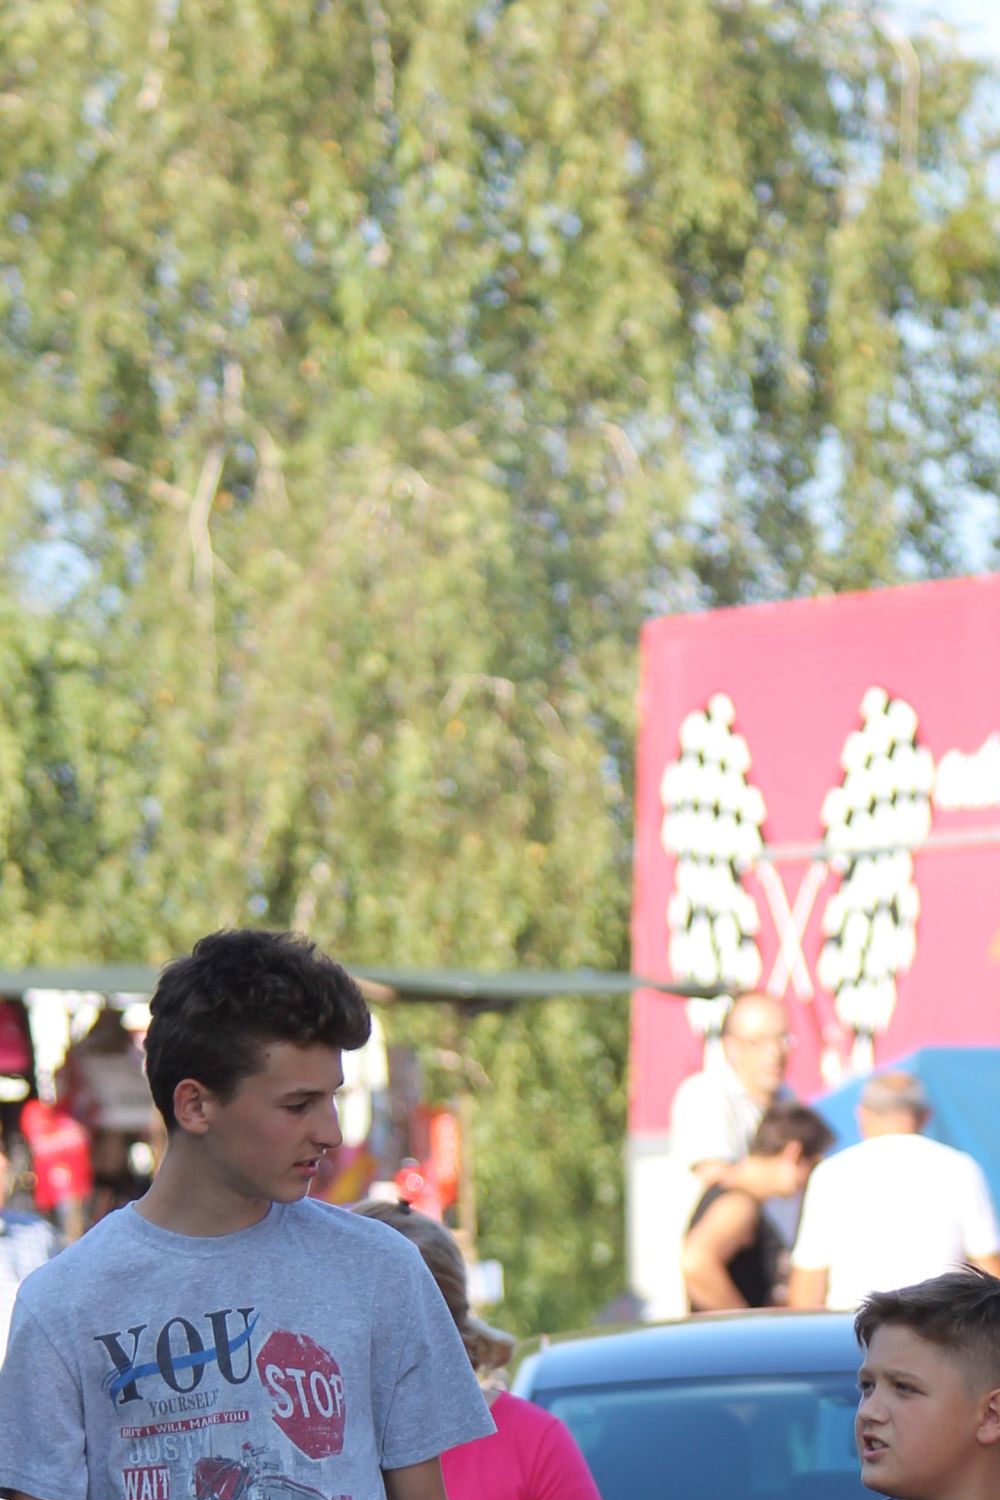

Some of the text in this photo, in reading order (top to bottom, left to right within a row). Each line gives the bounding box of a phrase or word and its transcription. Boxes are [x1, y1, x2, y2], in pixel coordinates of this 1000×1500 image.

[93, 1307, 255, 1404] YOU
[150, 1389, 219, 1417] YOURSELF
[265, 1363, 343, 1418] STOP
[122, 1427, 142, 1438] BUT
[156, 1421, 186, 1433] WILL
[189, 1415, 220, 1429] MAKE
[223, 1411, 246, 1422] YOU
[128, 1431, 203, 1465] JUST
